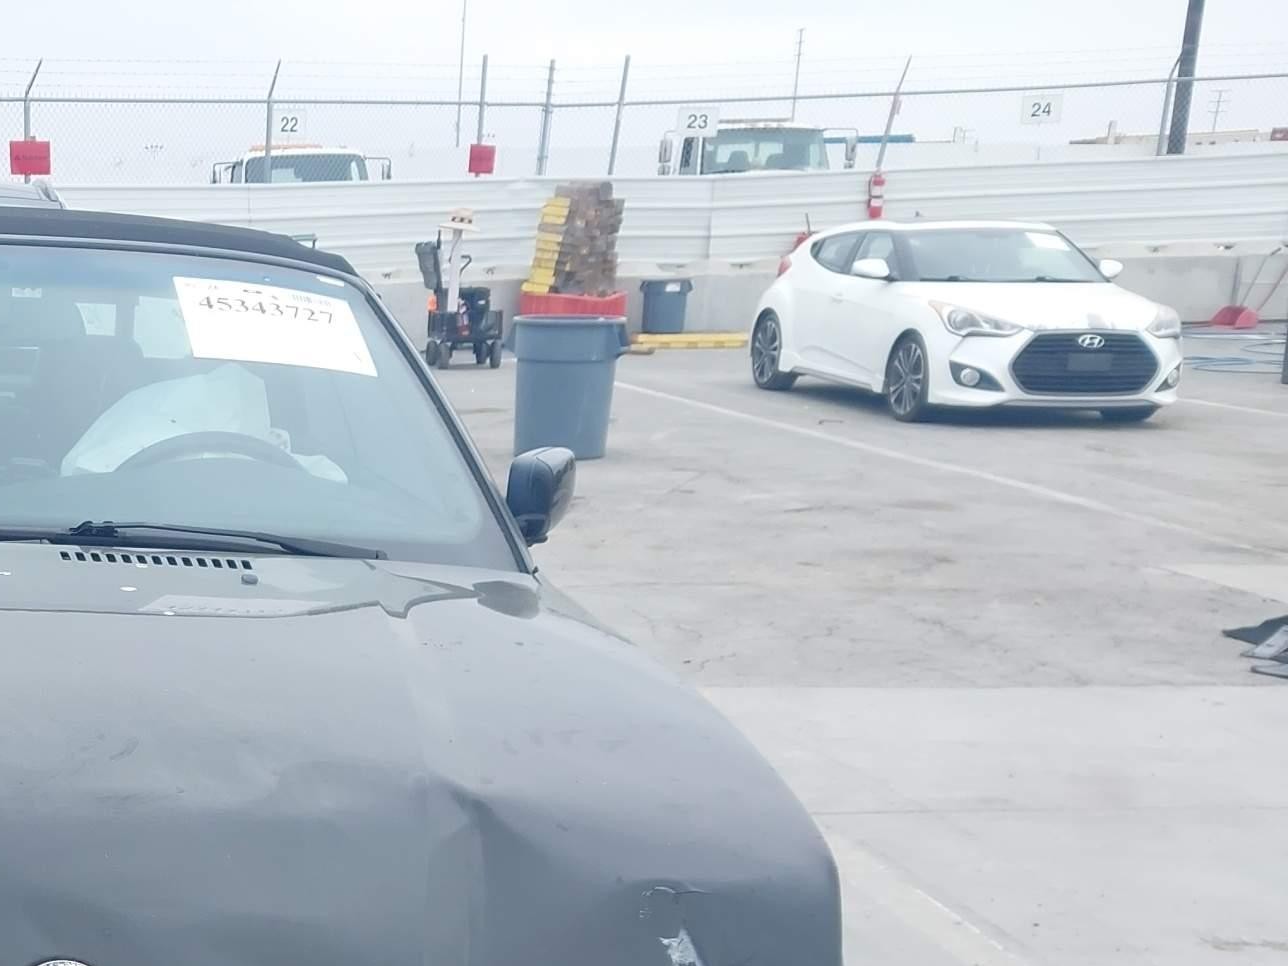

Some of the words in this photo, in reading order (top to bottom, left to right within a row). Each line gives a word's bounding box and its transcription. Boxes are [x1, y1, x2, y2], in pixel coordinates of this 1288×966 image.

[1031, 102, 1052, 117] 24
[280, 116, 298, 132] 22
[687, 113, 708, 129] 23
[199, 295, 333, 324] 45343727
